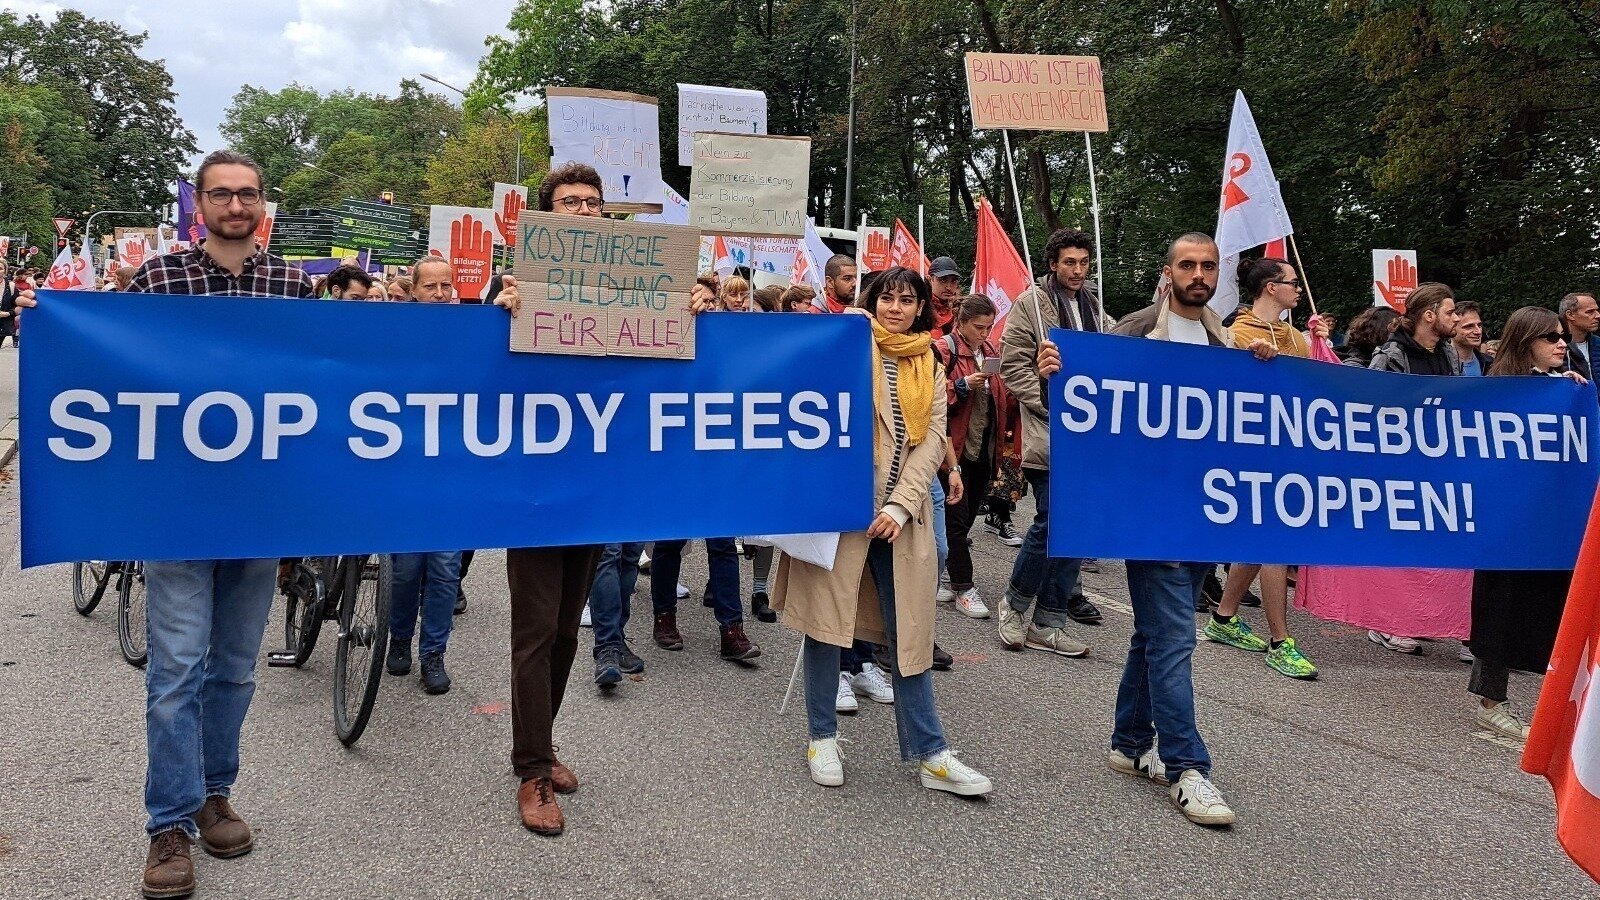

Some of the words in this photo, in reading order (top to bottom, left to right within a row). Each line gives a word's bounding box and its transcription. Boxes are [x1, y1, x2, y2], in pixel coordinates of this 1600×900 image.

[972, 58, 1039, 84] BILDUNG
[1047, 60, 1072, 85] IST
[1076, 62, 1102, 87] EIN
[561, 104, 611, 135] Bildung
[975, 89, 1105, 122] MENSCHENRECHT
[593, 135, 654, 169] RECHT
[700, 139, 730, 160] Nein
[733, 149, 752, 160] zur
[697, 162, 794, 191] Kommerzialisierung
[697, 188, 714, 200] der
[719, 188, 755, 208] Bildung
[710, 206, 748, 230] Bayern
[750, 208, 761, 225] &
[762, 208, 802, 228] TUM
[522, 223, 669, 267] KOSTENFREIE
[453, 257, 487, 266] Bildungs-
[457, 267, 483, 275] wende
[457, 275, 482, 283] JETZT!
[547, 268, 674, 311] BILDUNG
[533, 311, 605, 349] FÜR
[616, 307, 694, 355] ALLE!
[47, 389, 318, 462] STOP
[347, 391, 625, 460] STUDY
[649, 390, 851, 452] FEES!
[1061, 375, 1589, 463] STUDIENGEBÜHREN
[1203, 468, 1475, 532] STOPPEN!
